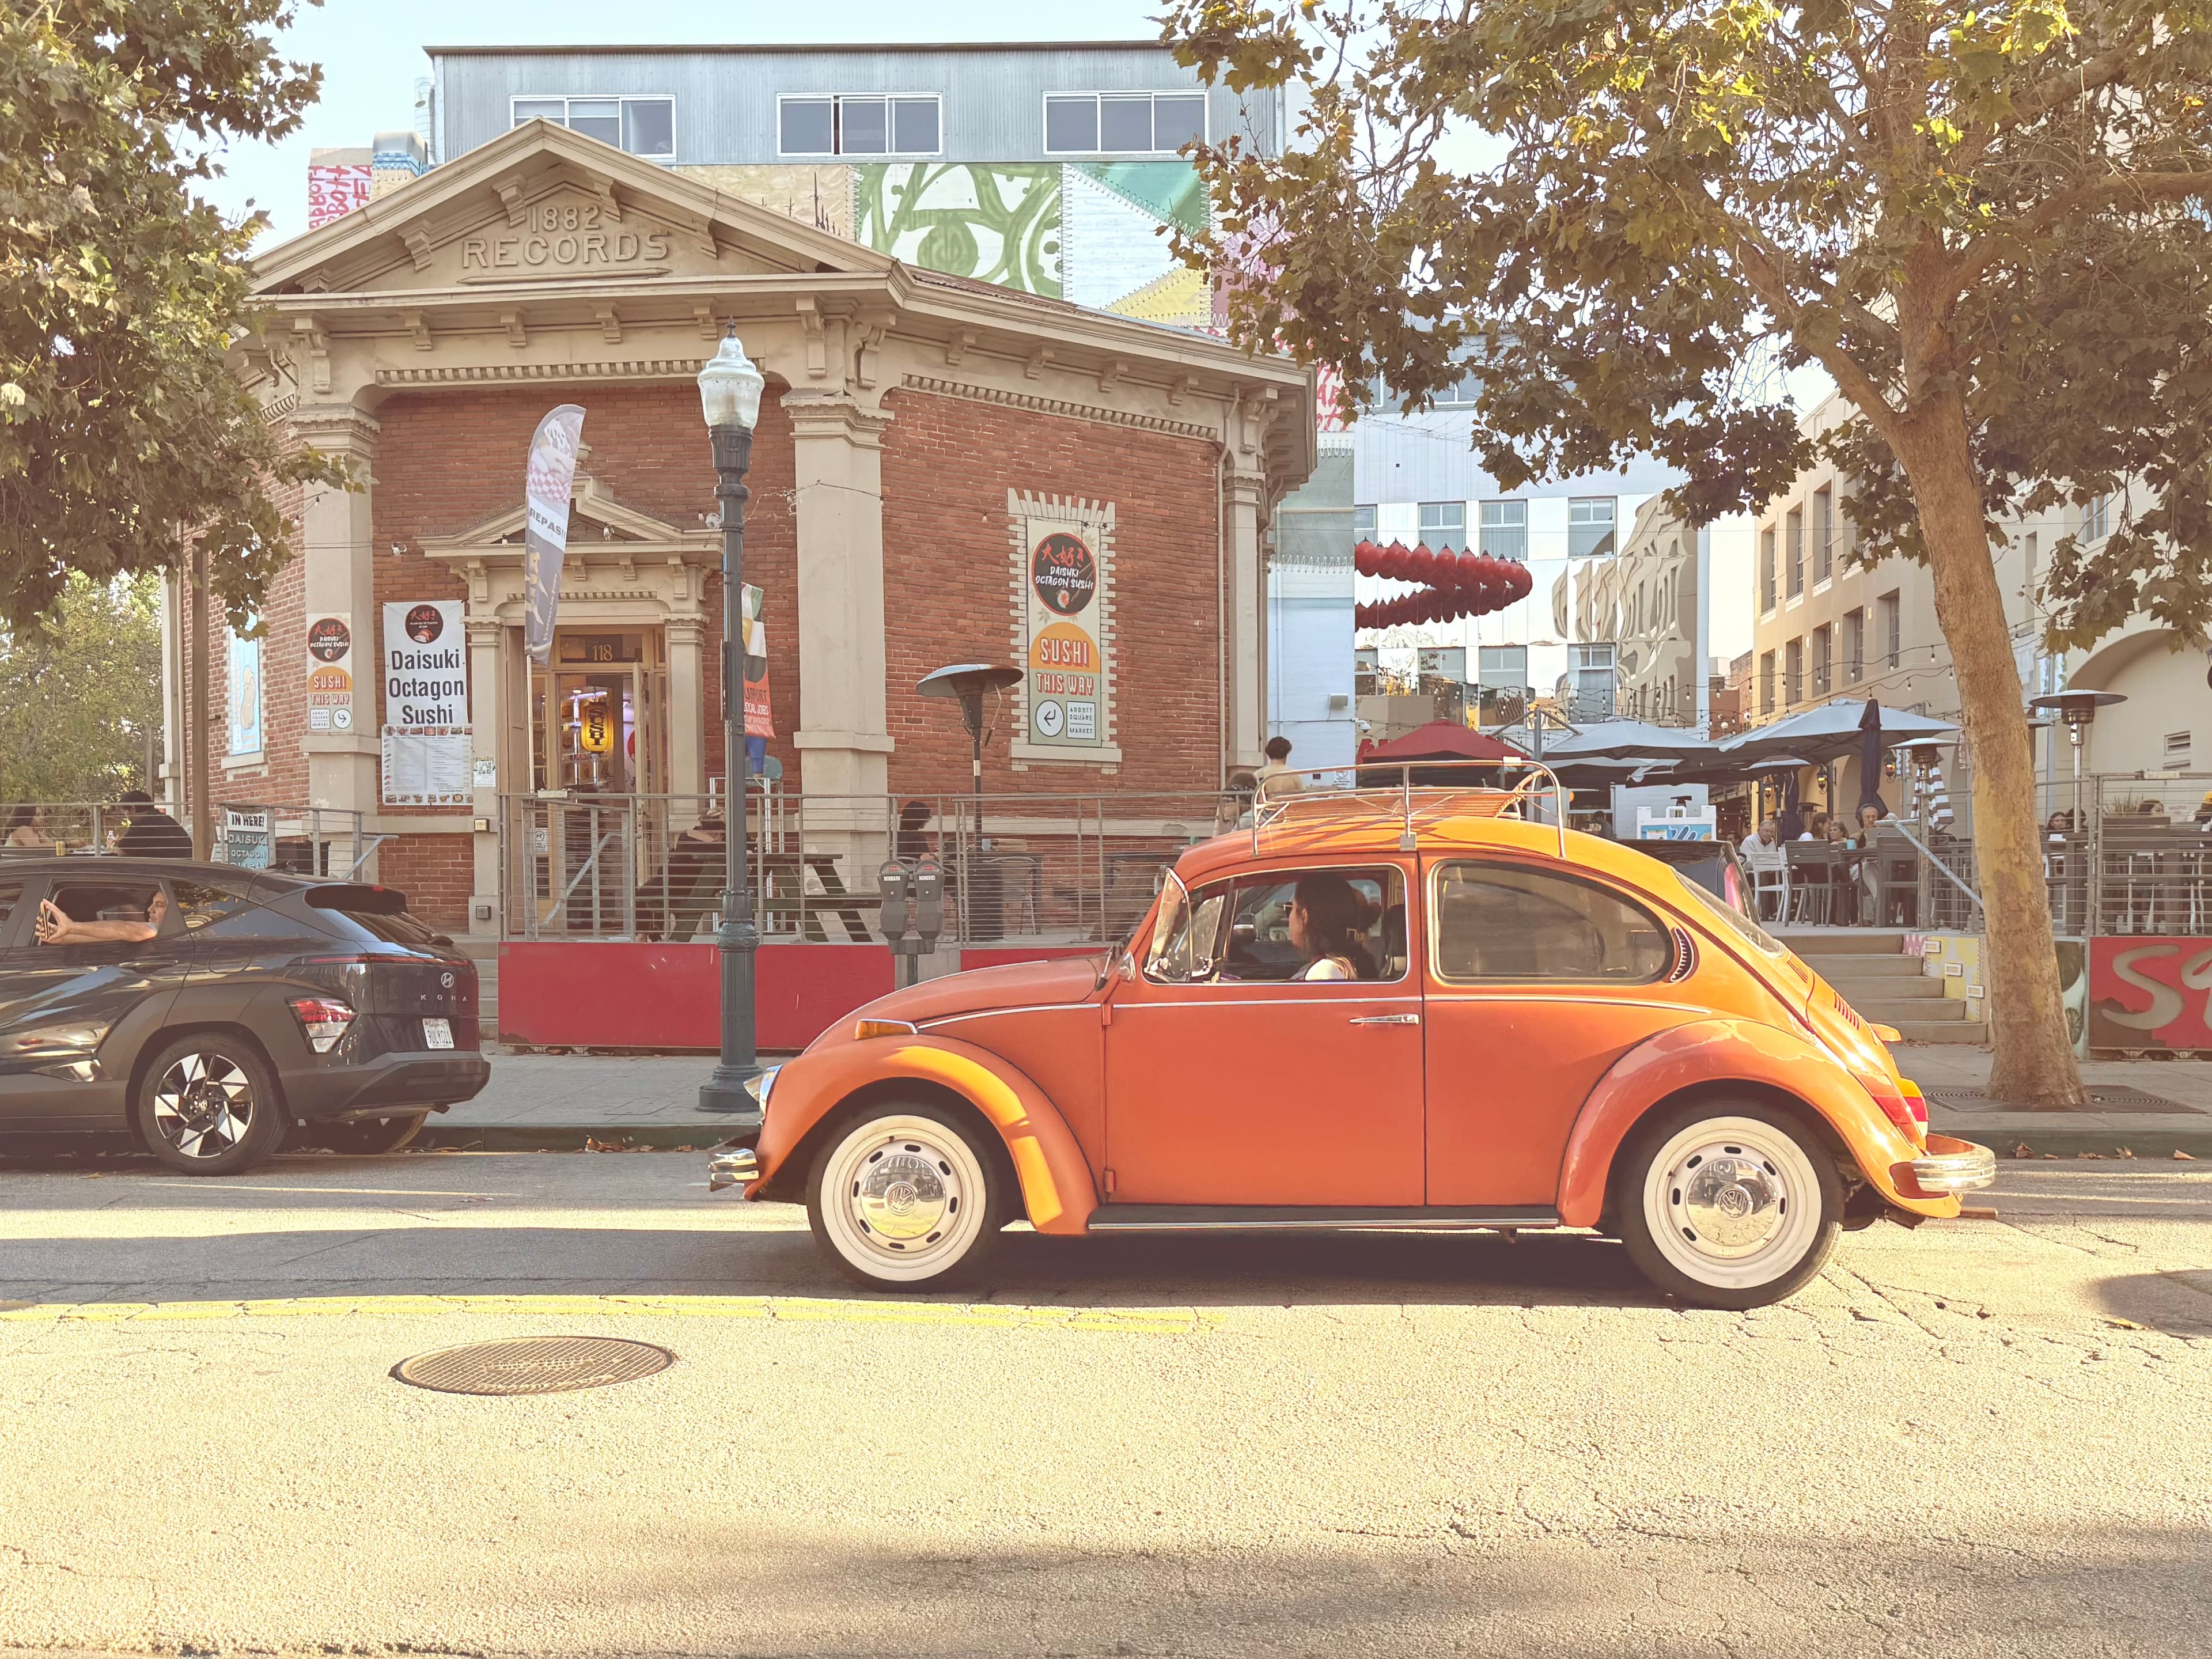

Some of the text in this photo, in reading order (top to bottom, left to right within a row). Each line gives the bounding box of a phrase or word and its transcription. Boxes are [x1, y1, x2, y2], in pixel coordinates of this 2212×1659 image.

[531, 203, 600, 232] 1882
[463, 230, 669, 268] RECORDS
[1050, 566, 1079, 577] DAISUKI
[1035, 575, 1093, 590] OCTAGON SUSHI
[392, 649, 460, 670] Daisuki
[592, 644, 613, 661] 118
[1040, 637, 1090, 667] SUSHI
[313, 675, 346, 690] SUSHI
[389, 677, 464, 700] Octagon
[1036, 673, 1094, 696] THIS WAY
[310, 694, 350, 705] THIS WAY
[402, 704, 453, 724] Sushi
[589, 707, 605, 745] SUSHI
[232, 814, 264, 827] IN HERE!
